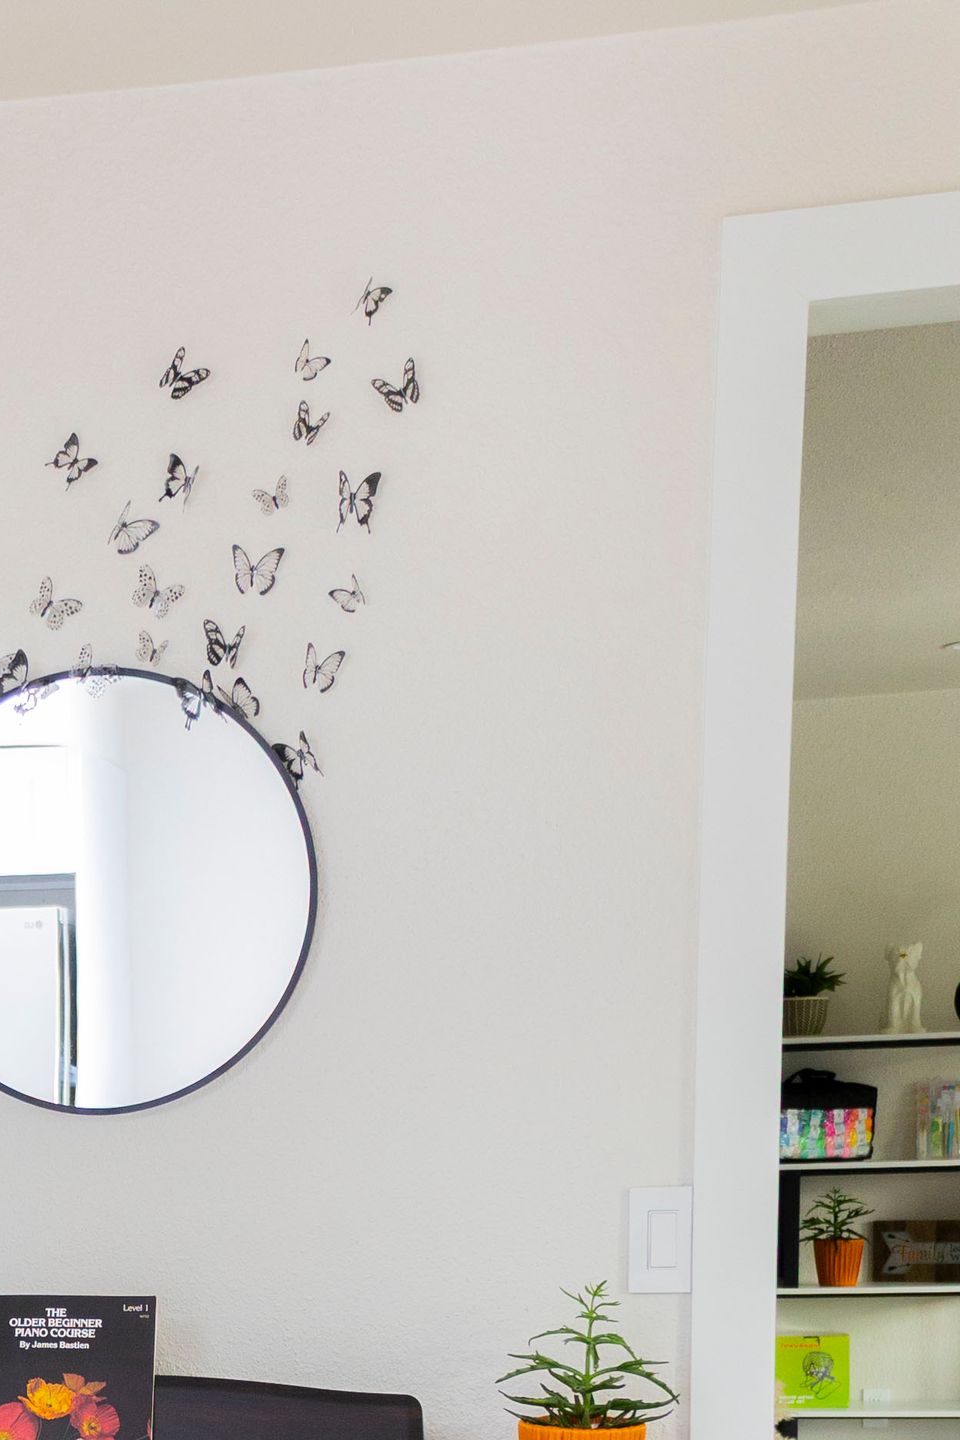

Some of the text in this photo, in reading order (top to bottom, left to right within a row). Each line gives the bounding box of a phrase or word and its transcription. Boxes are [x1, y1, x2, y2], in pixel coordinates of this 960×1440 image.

[45, 1308, 68, 1317] THE
[123, 1304, 143, 1312] Level
[9, 1318, 102, 1328] OLDER BEGINNER
[15, 1328, 95, 1338] PIANO COURSE
[20, 1341, 89, 1350] By James Bastien
